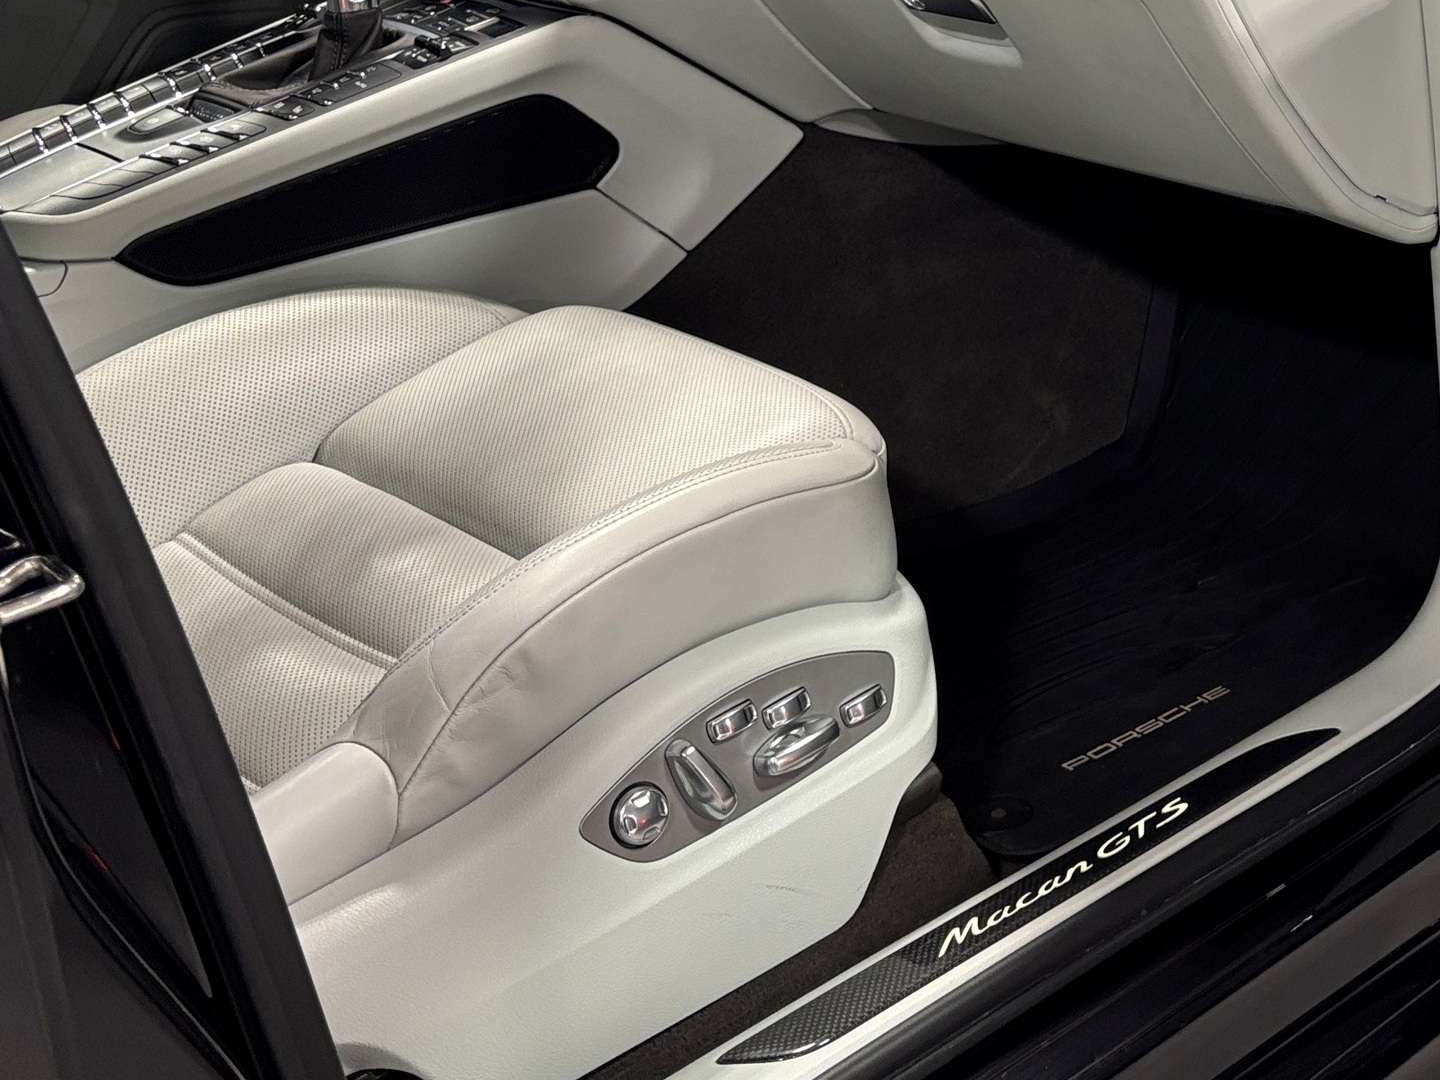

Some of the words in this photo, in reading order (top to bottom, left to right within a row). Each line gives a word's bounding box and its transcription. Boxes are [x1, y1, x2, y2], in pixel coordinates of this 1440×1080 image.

[1062, 685, 1231, 771] PORSCHE
[938, 860, 1094, 958] Macan
[1097, 796, 1189, 859] GTS
